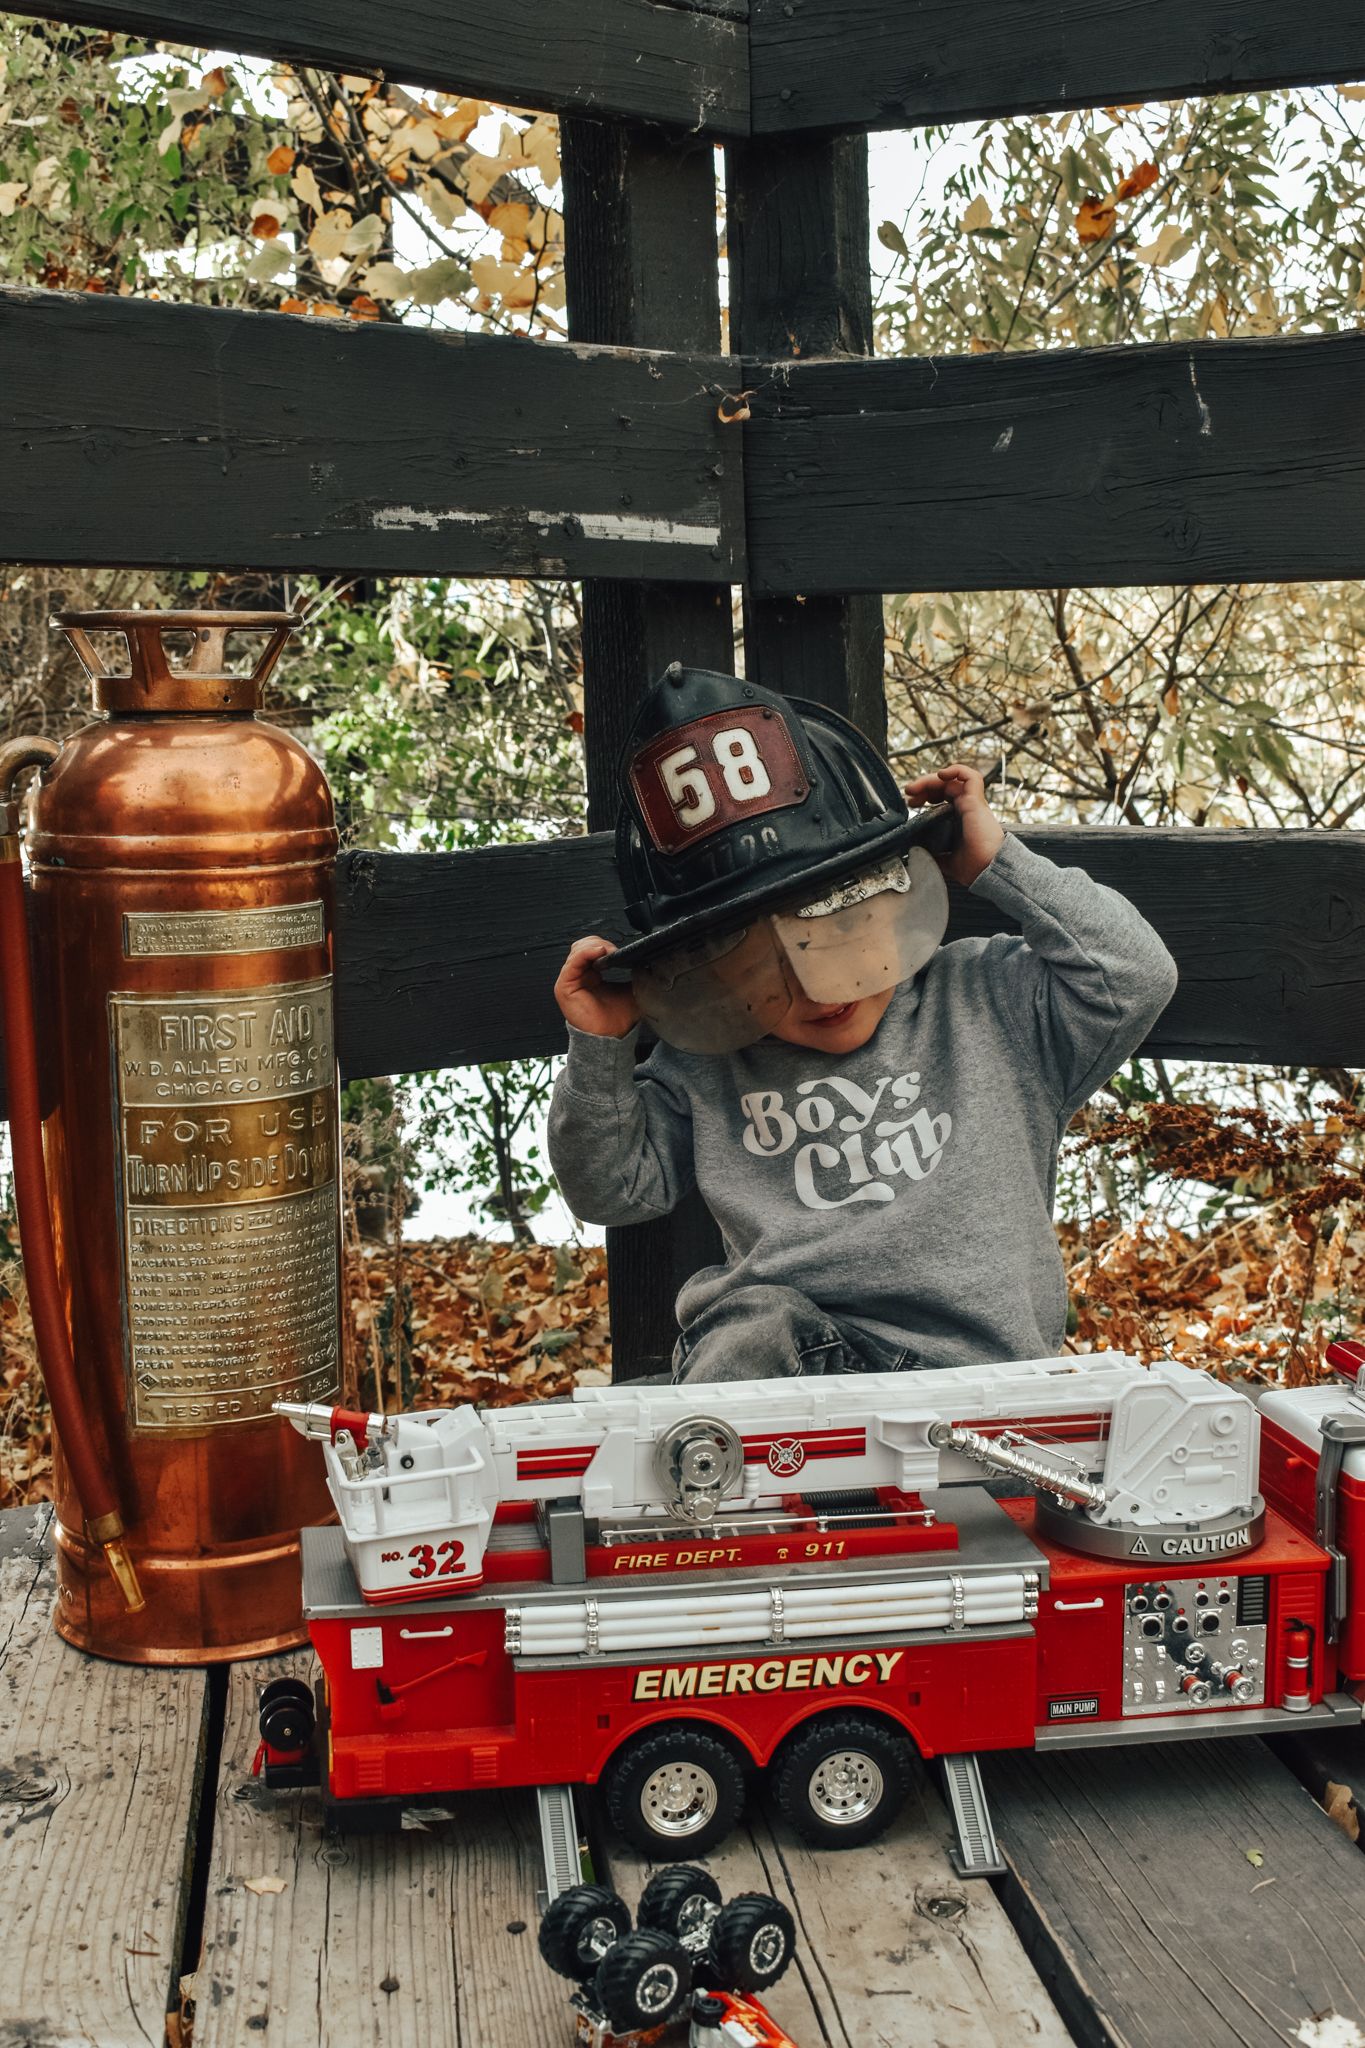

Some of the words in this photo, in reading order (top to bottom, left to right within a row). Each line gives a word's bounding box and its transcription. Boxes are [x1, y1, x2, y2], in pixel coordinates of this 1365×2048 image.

[660, 728, 772, 829] 58
[159, 1012, 257, 1051] FIRST
[269, 1004, 314, 1048] AID
[140, 1118, 232, 1146] FOR
[128, 1155, 188, 1196] TURN
[794, 1107, 953, 1210] Club
[132, 1214, 244, 1237] DIRECTIONS
[275, 1192, 334, 1226] CHARGING
[133, 1317, 188, 1327] STOPPLE
[192, 1298, 247, 1311] REPLACE
[160, 1371, 239, 1388] PROTECT
[245, 1362, 287, 1381] FROM
[291, 1348, 327, 1369] FROST
[161, 1400, 242, 1418] TESTED
[381, 1551, 404, 1563] NO.
[408, 1540, 467, 1579] 32
[613, 1552, 669, 1570] FIRE
[675, 1548, 743, 1566] DEPT.
[804, 1541, 847, 1557] 911
[1161, 1528, 1249, 1555] CAUTION
[632, 1651, 904, 1701] EMERGENCY
[1052, 1703, 1072, 1715] MAIN
[1074, 1701, 1096, 1713] PUMP
